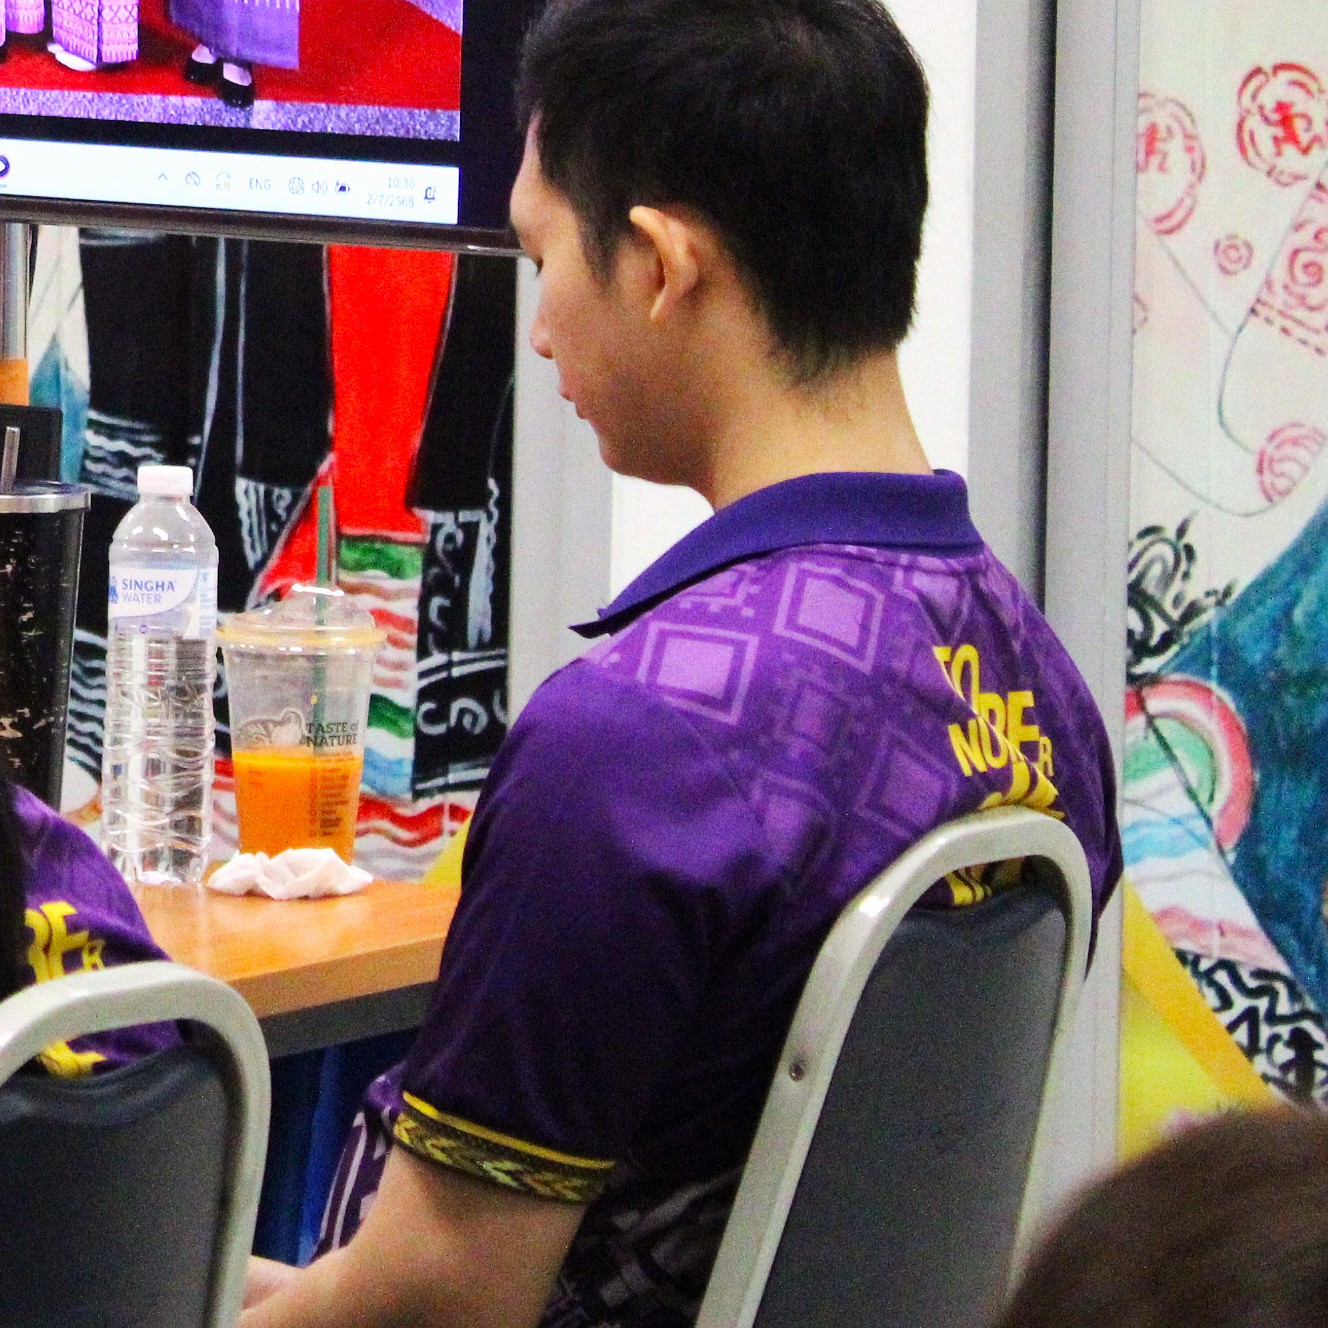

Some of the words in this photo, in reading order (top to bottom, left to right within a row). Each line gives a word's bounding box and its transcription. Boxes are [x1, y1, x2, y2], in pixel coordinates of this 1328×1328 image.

[248, 177, 272, 191] ENG
[122, 578, 176, 593] SINGHA
[122, 591, 163, 606] WATER
[306, 721, 348, 736] TASTE
[305, 732, 358, 748] NATURE
